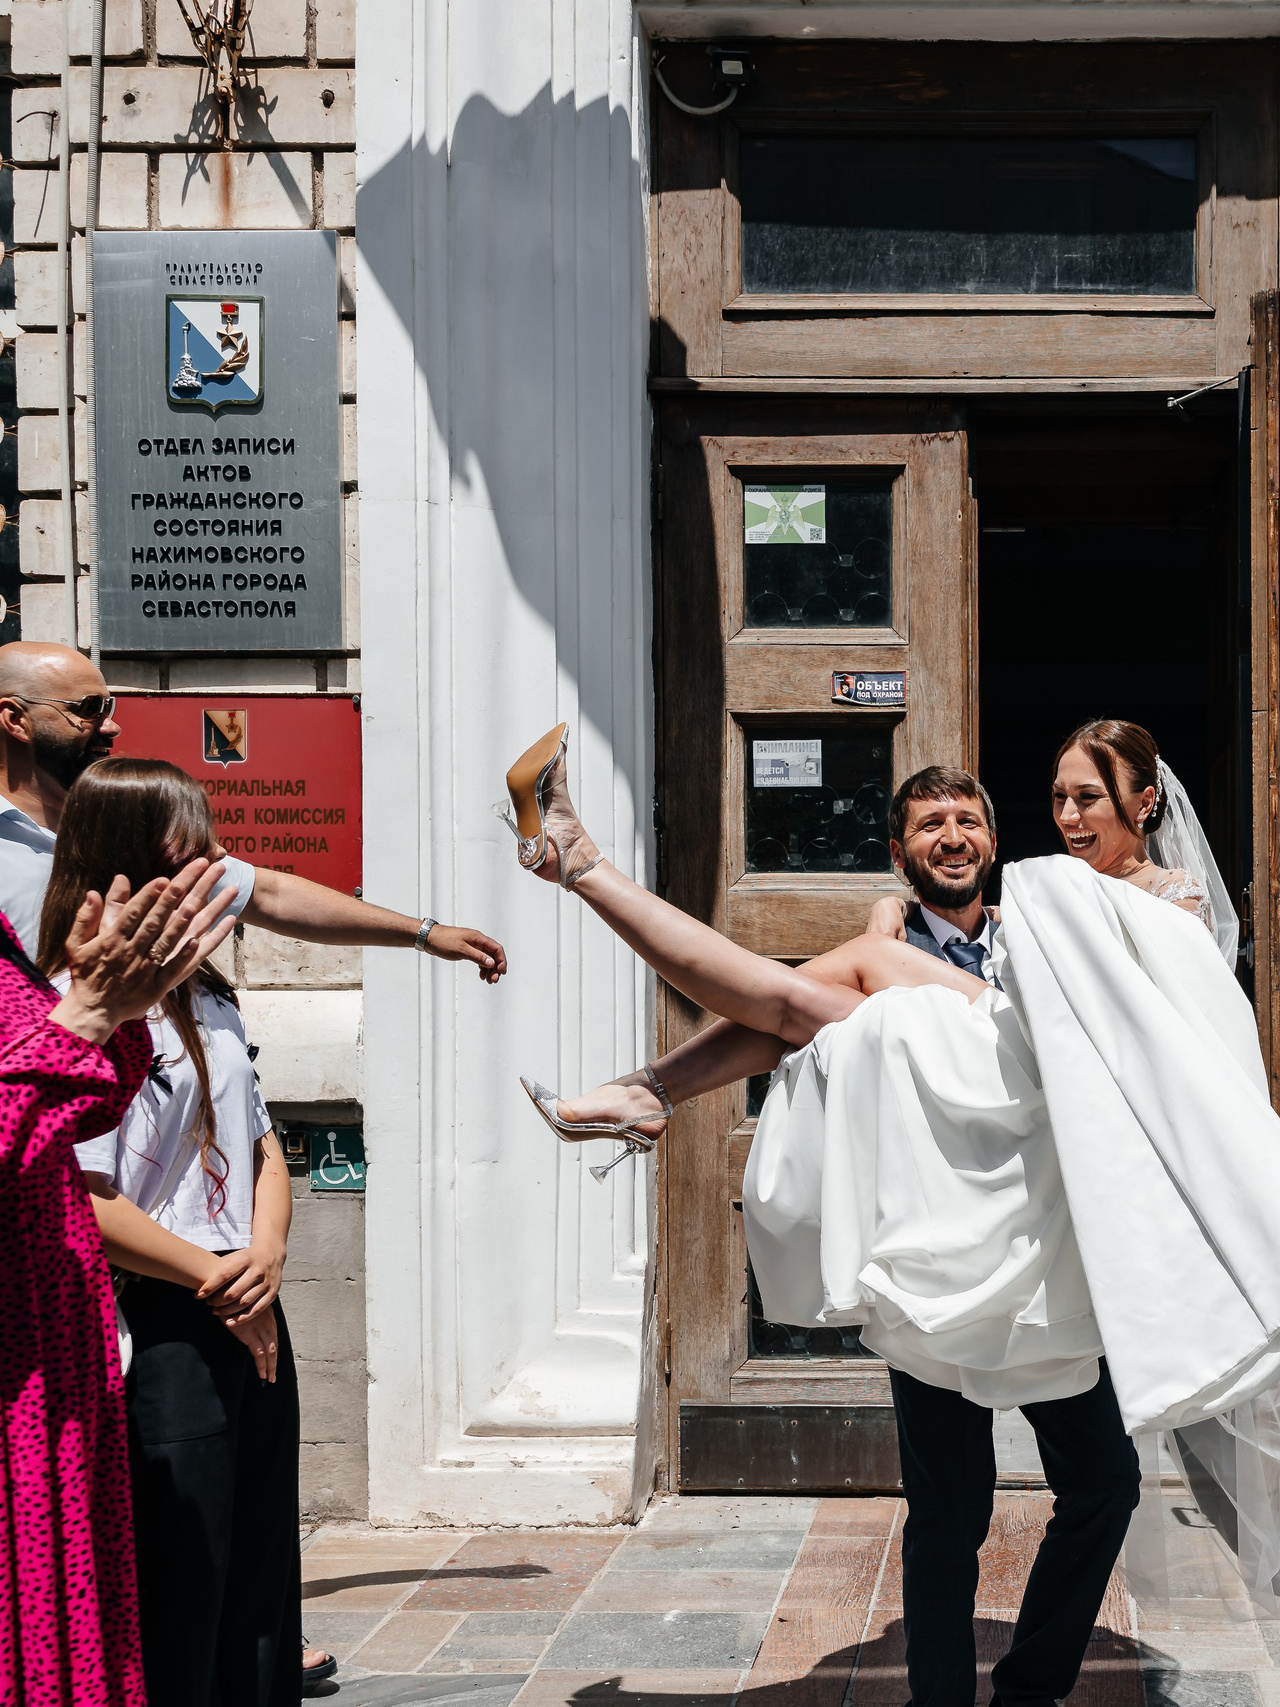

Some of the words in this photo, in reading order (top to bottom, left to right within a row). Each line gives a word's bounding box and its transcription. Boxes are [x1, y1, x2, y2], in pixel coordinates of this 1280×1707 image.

[165, 263, 263, 274] ПРАВИТЕЛЬСТВО
[169, 274, 258, 286] СЕВАСТОПОЛЯ
[138, 437, 205, 457] ОТДЕЛ
[211, 437, 295, 456] ЗАПИСИ
[182, 464, 252, 483] АКТОВ
[131, 491, 304, 511] ГРАЖДАНСКОГО
[153, 518, 283, 537] СОСТОЯНИЯ
[131, 545, 305, 564] НАХИМОВСКОГО
[131, 569, 215, 591] РАЙОНА
[222, 573, 307, 593] ГОРОДА
[141, 600, 296, 618] СЕВАСТОПОЛЯ
[856, 681, 903, 691] ОБЪЕКТ
[872, 690, 903, 698] ОХРАНОЙ
[756, 742, 819, 753] ВНИМАНИЕ!
[254, 808, 345, 825] КОМИССИЯ
[261, 832, 329, 853] РАЙОНА
